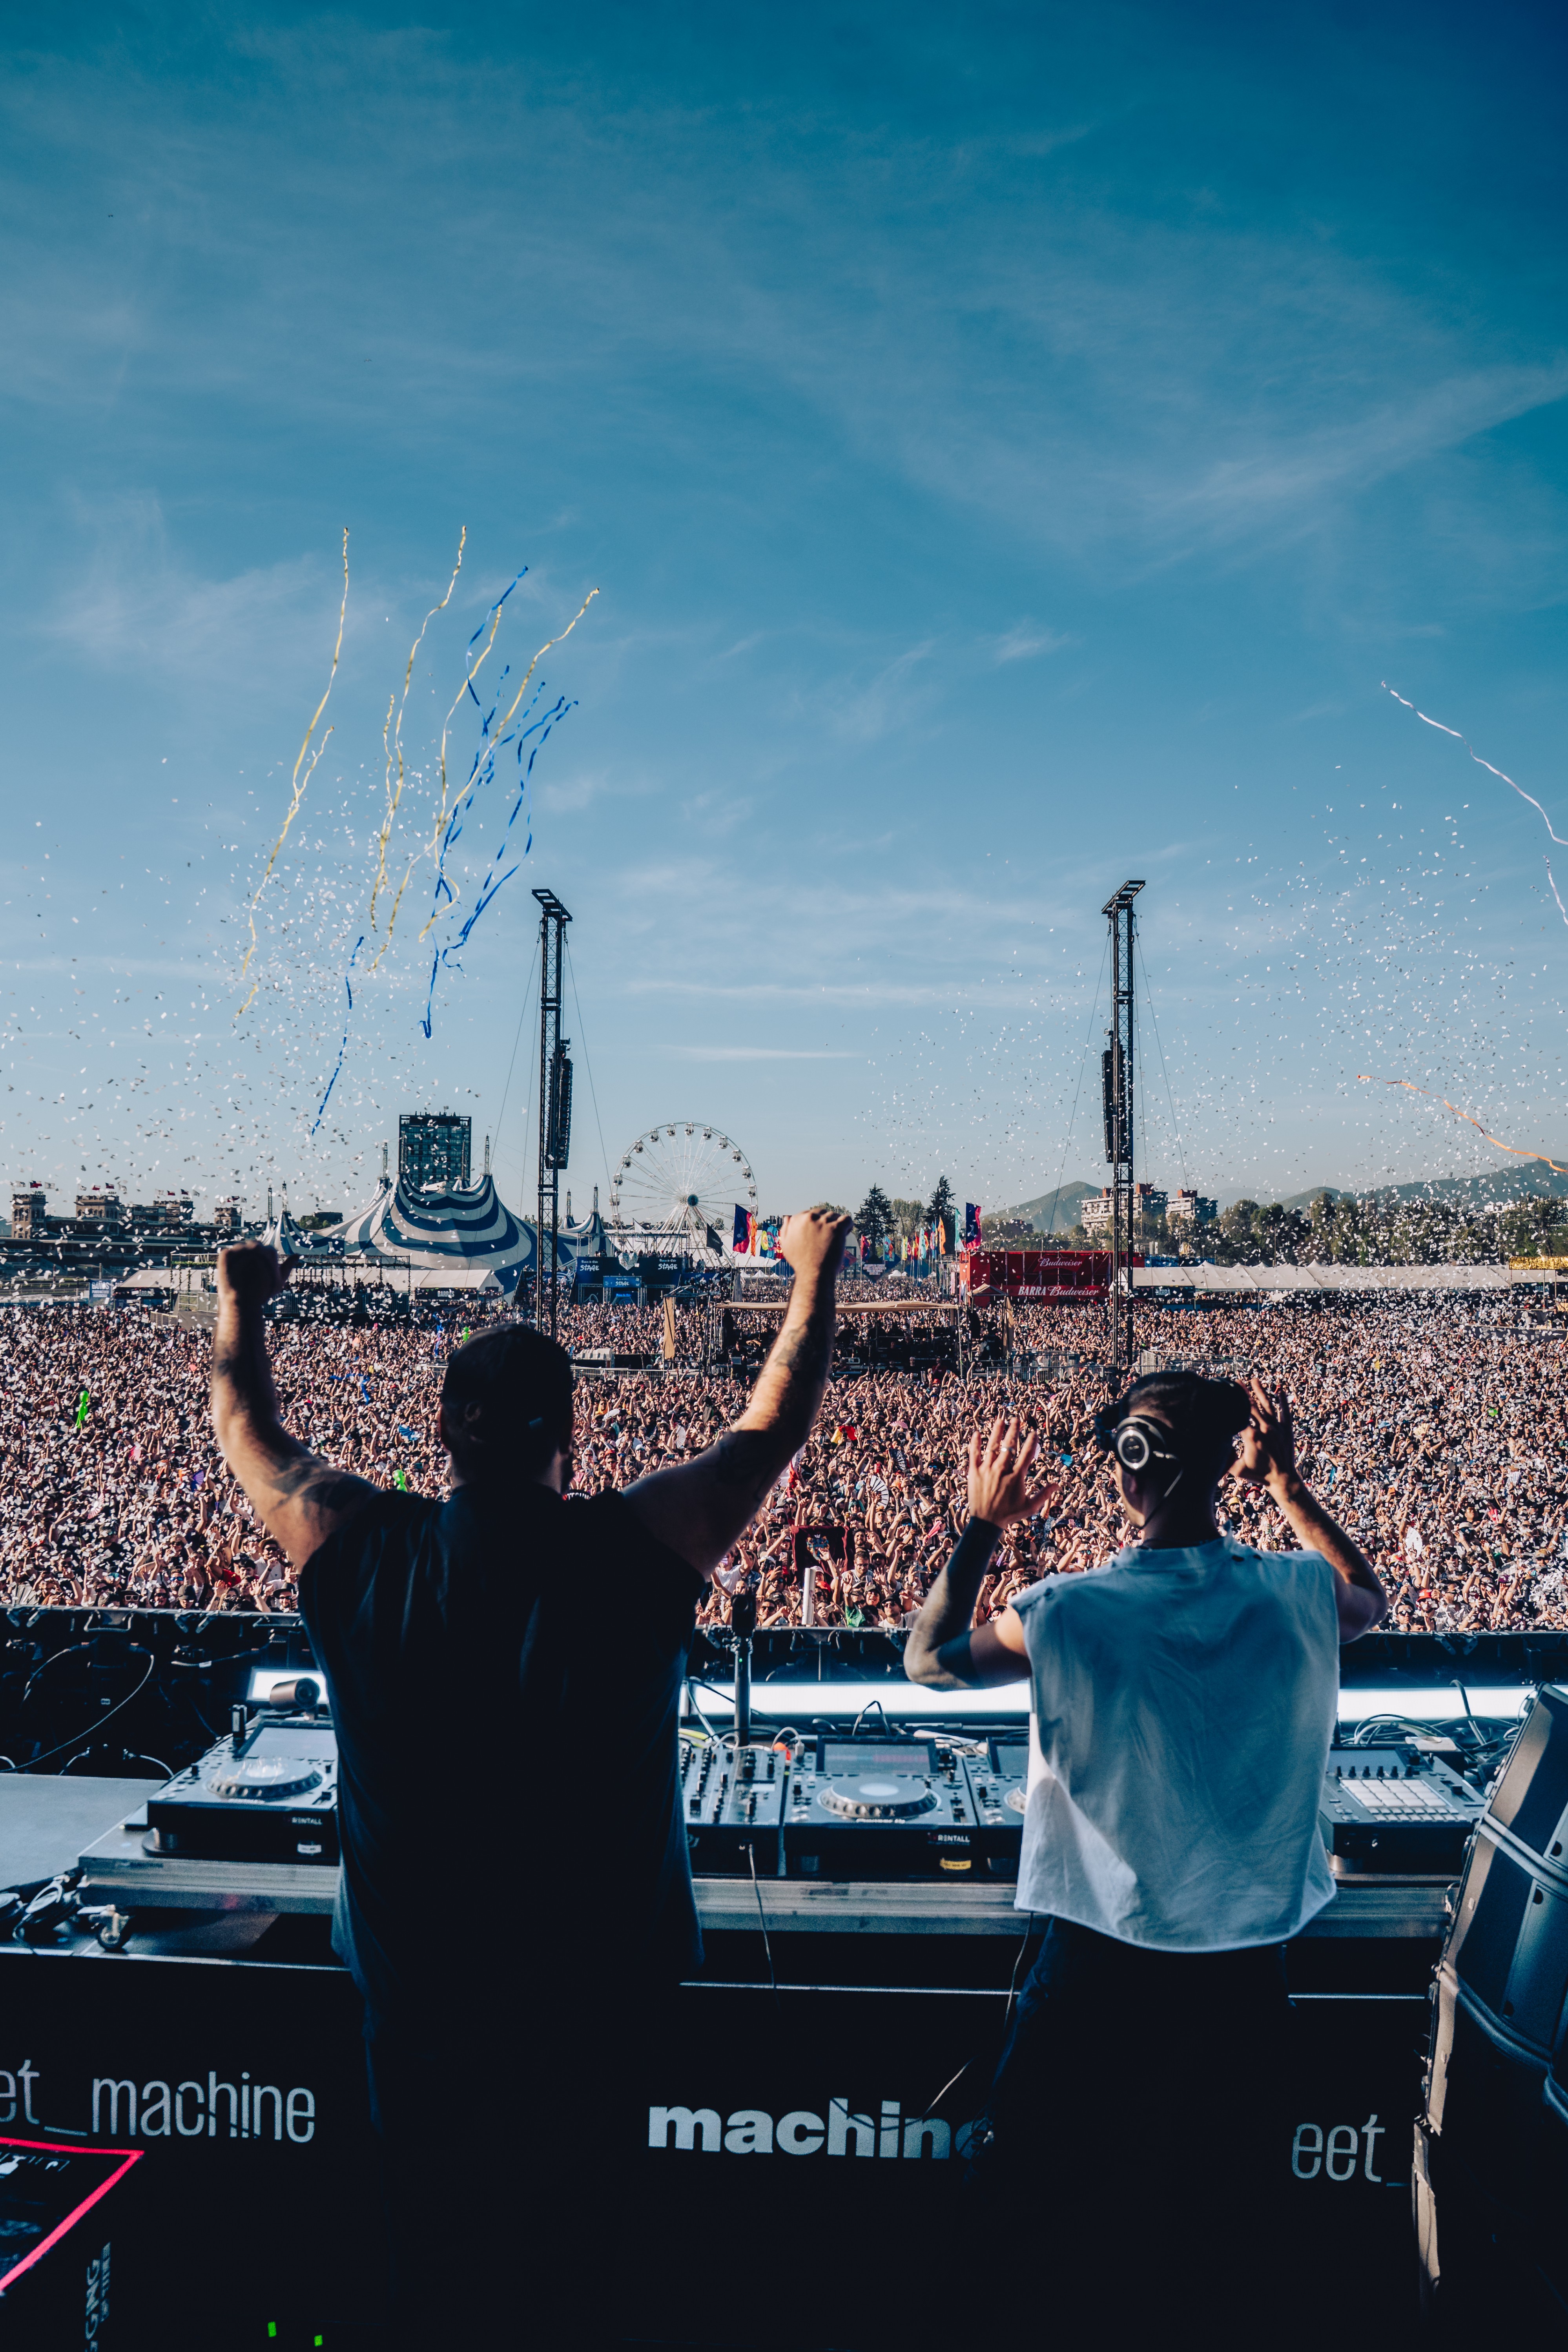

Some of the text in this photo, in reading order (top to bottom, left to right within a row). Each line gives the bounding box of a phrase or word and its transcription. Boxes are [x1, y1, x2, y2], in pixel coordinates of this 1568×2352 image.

[1038, 1258, 1082, 1267] Budweiser
[1018, 1286, 1100, 1296] BARRA Budweiser
